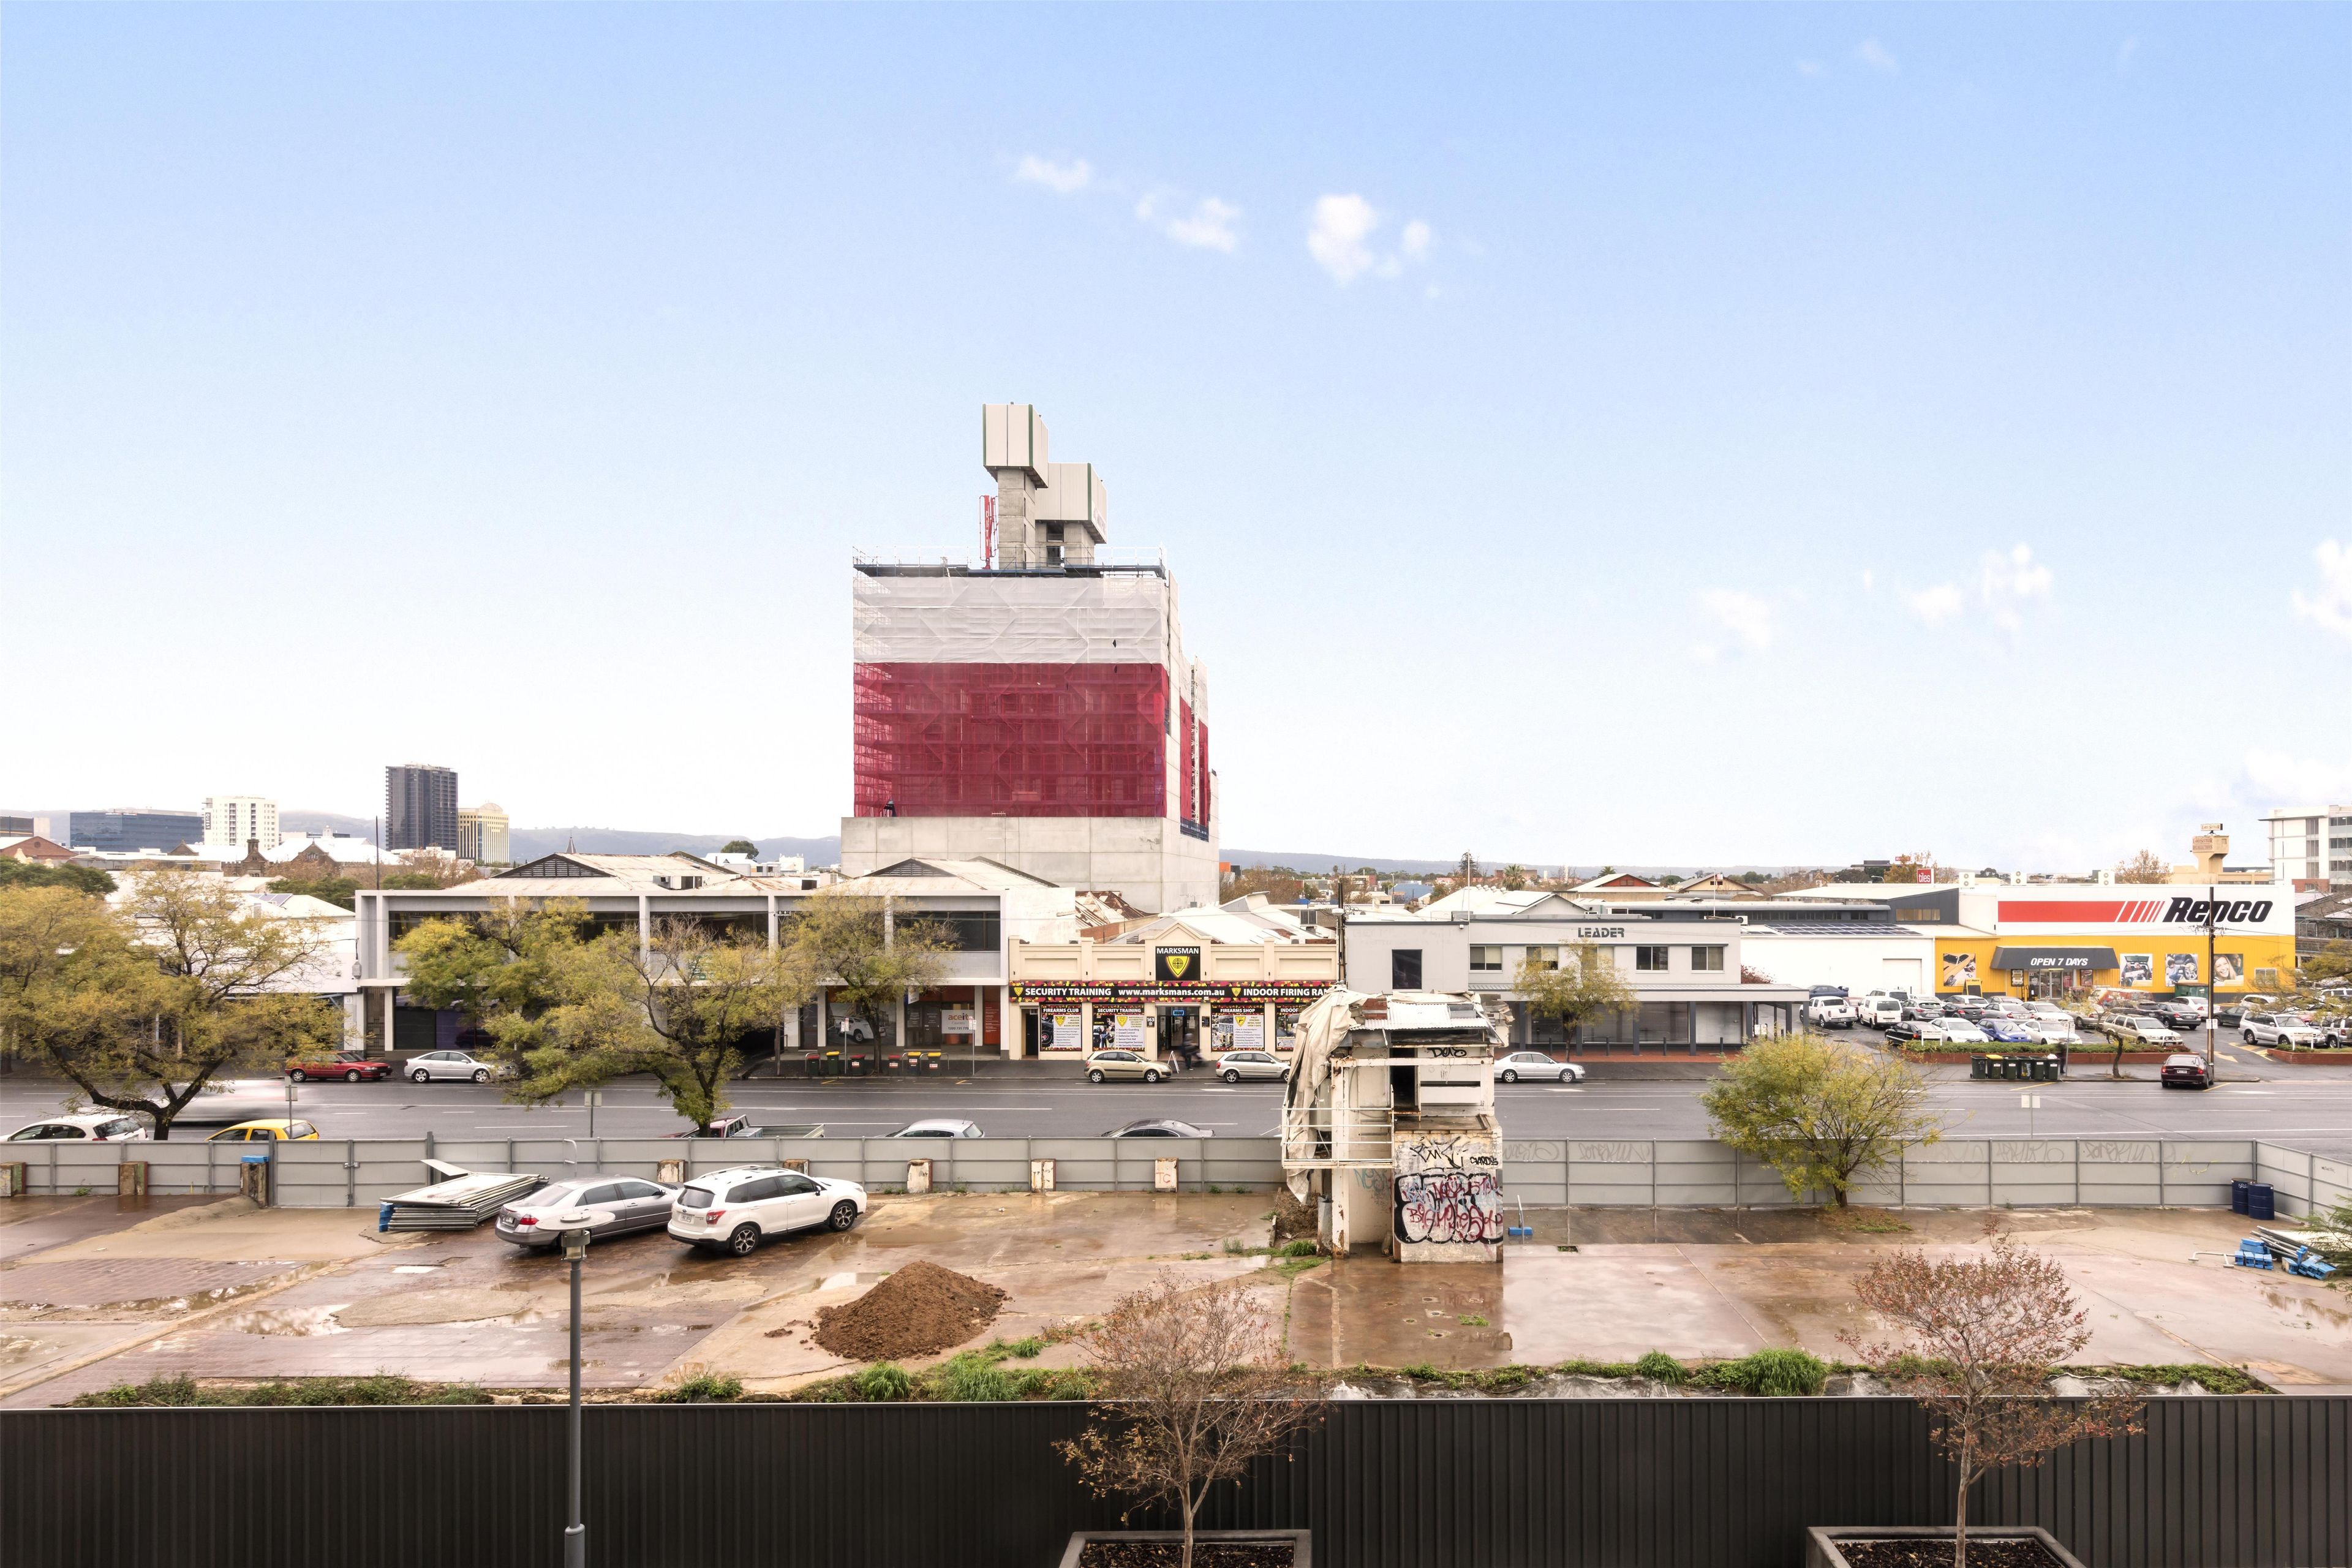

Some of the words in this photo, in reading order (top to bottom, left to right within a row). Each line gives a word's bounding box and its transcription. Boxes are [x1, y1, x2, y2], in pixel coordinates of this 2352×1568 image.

[1918, 873, 1931, 883] tiles
[2162, 897, 2274, 926] Repco
[1578, 927, 1625, 938] LEADER
[2030, 957, 2056, 966] OPEN
[2065, 957, 2089, 966] DAYS
[1118, 987, 1224, 996] www.marksmans.com.au
[1243, 988, 1278, 997] INDOOR
[1280, 988, 1310, 997] FIRING
